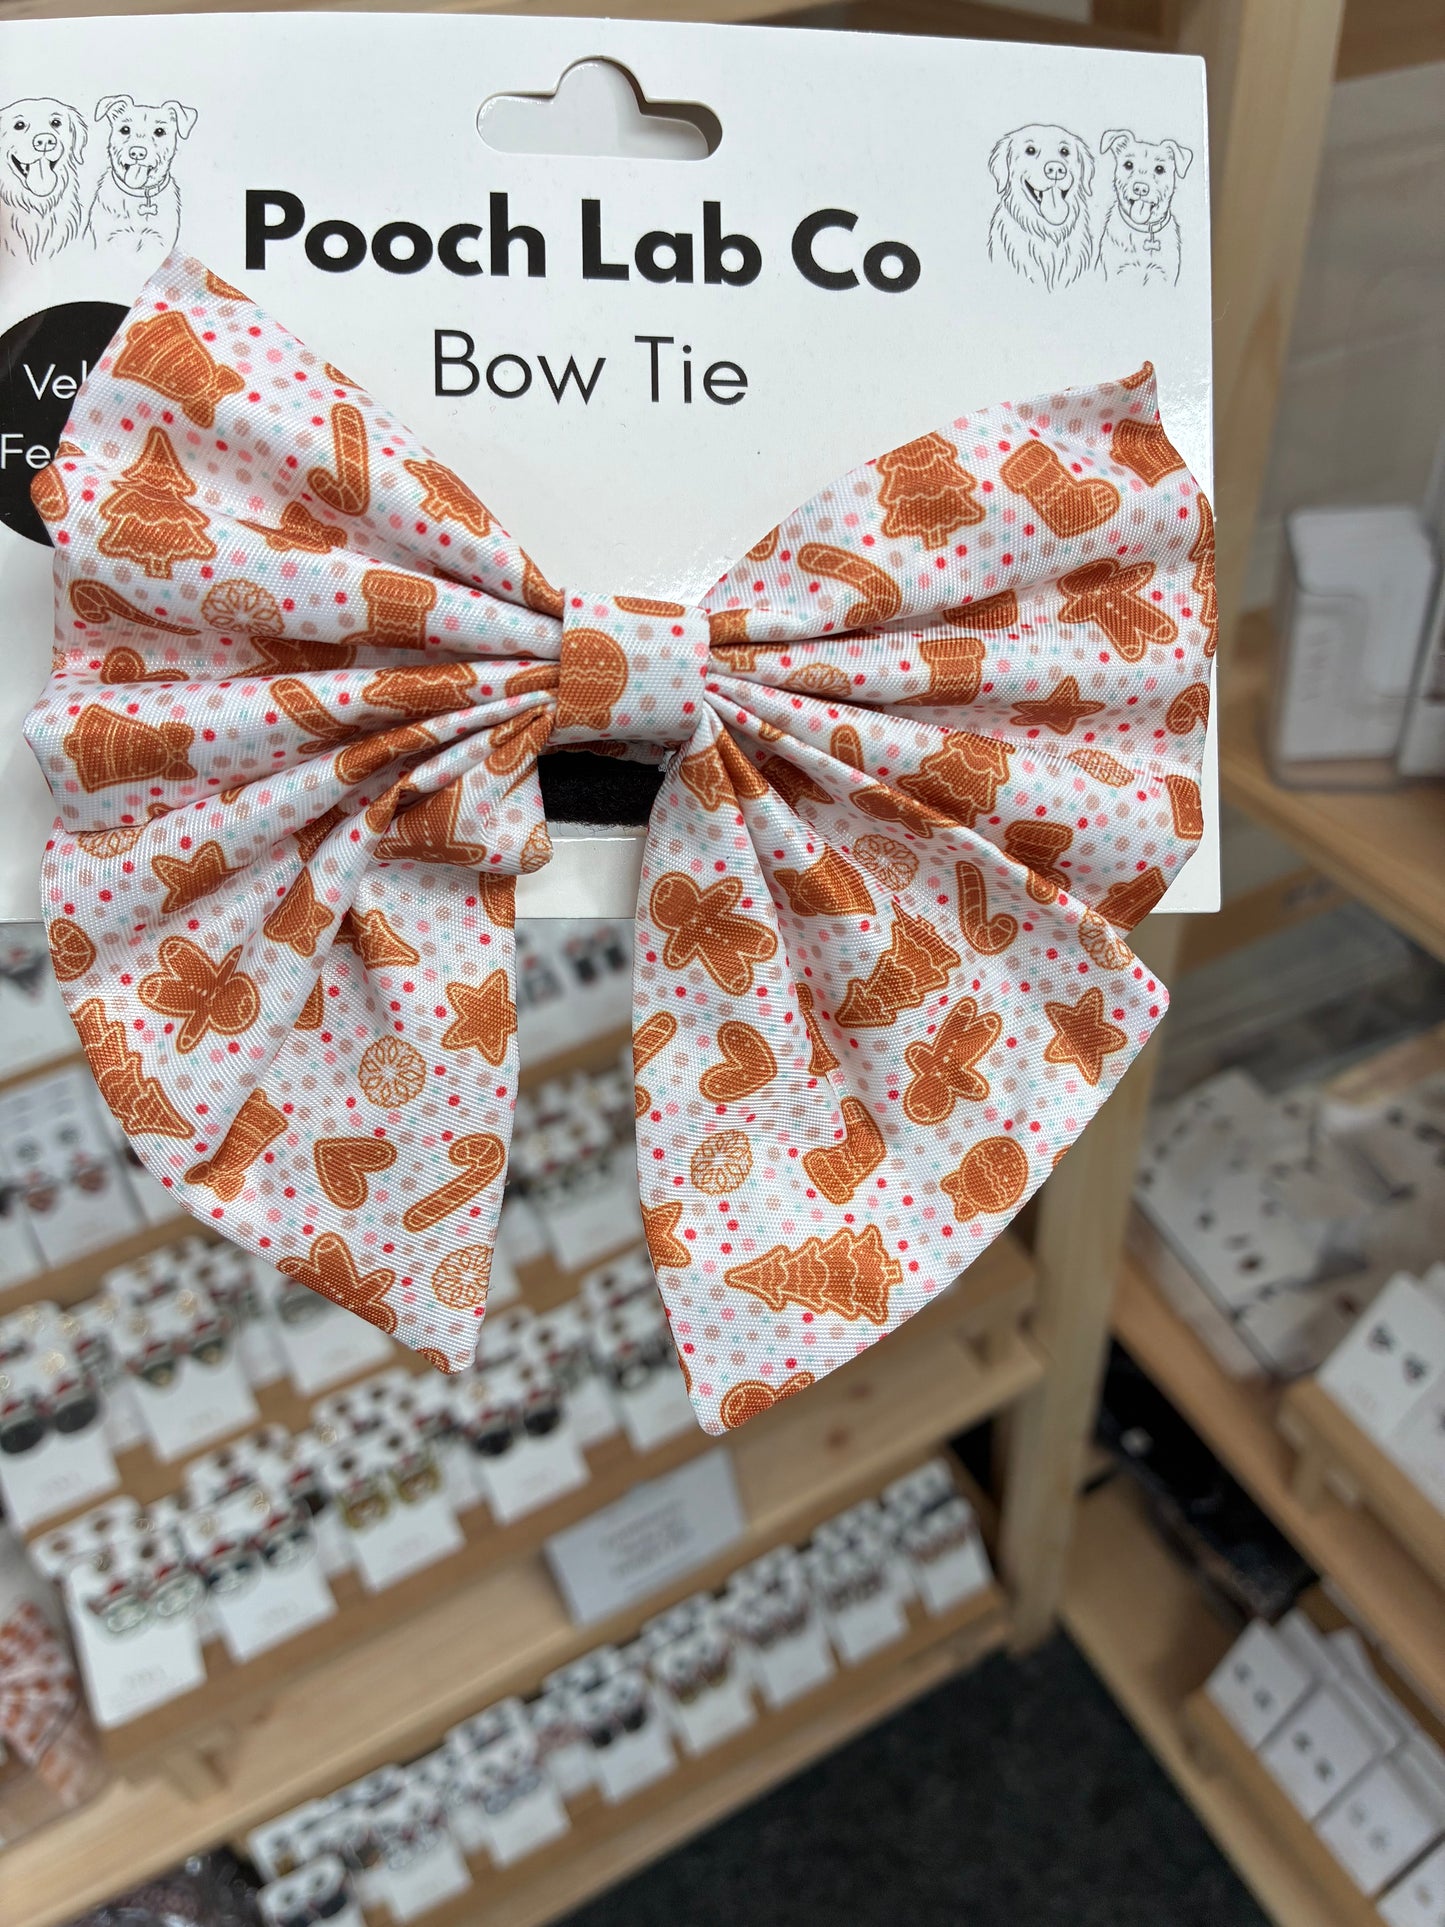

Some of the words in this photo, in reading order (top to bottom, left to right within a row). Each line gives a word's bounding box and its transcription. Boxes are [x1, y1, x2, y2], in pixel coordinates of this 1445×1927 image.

[245, 189, 546, 278] Pooch
[581, 198, 763, 287] Lab
[791, 208, 921, 293] Co
[434, 329, 607, 405] Bow
[634, 335, 748, 406] Tie
